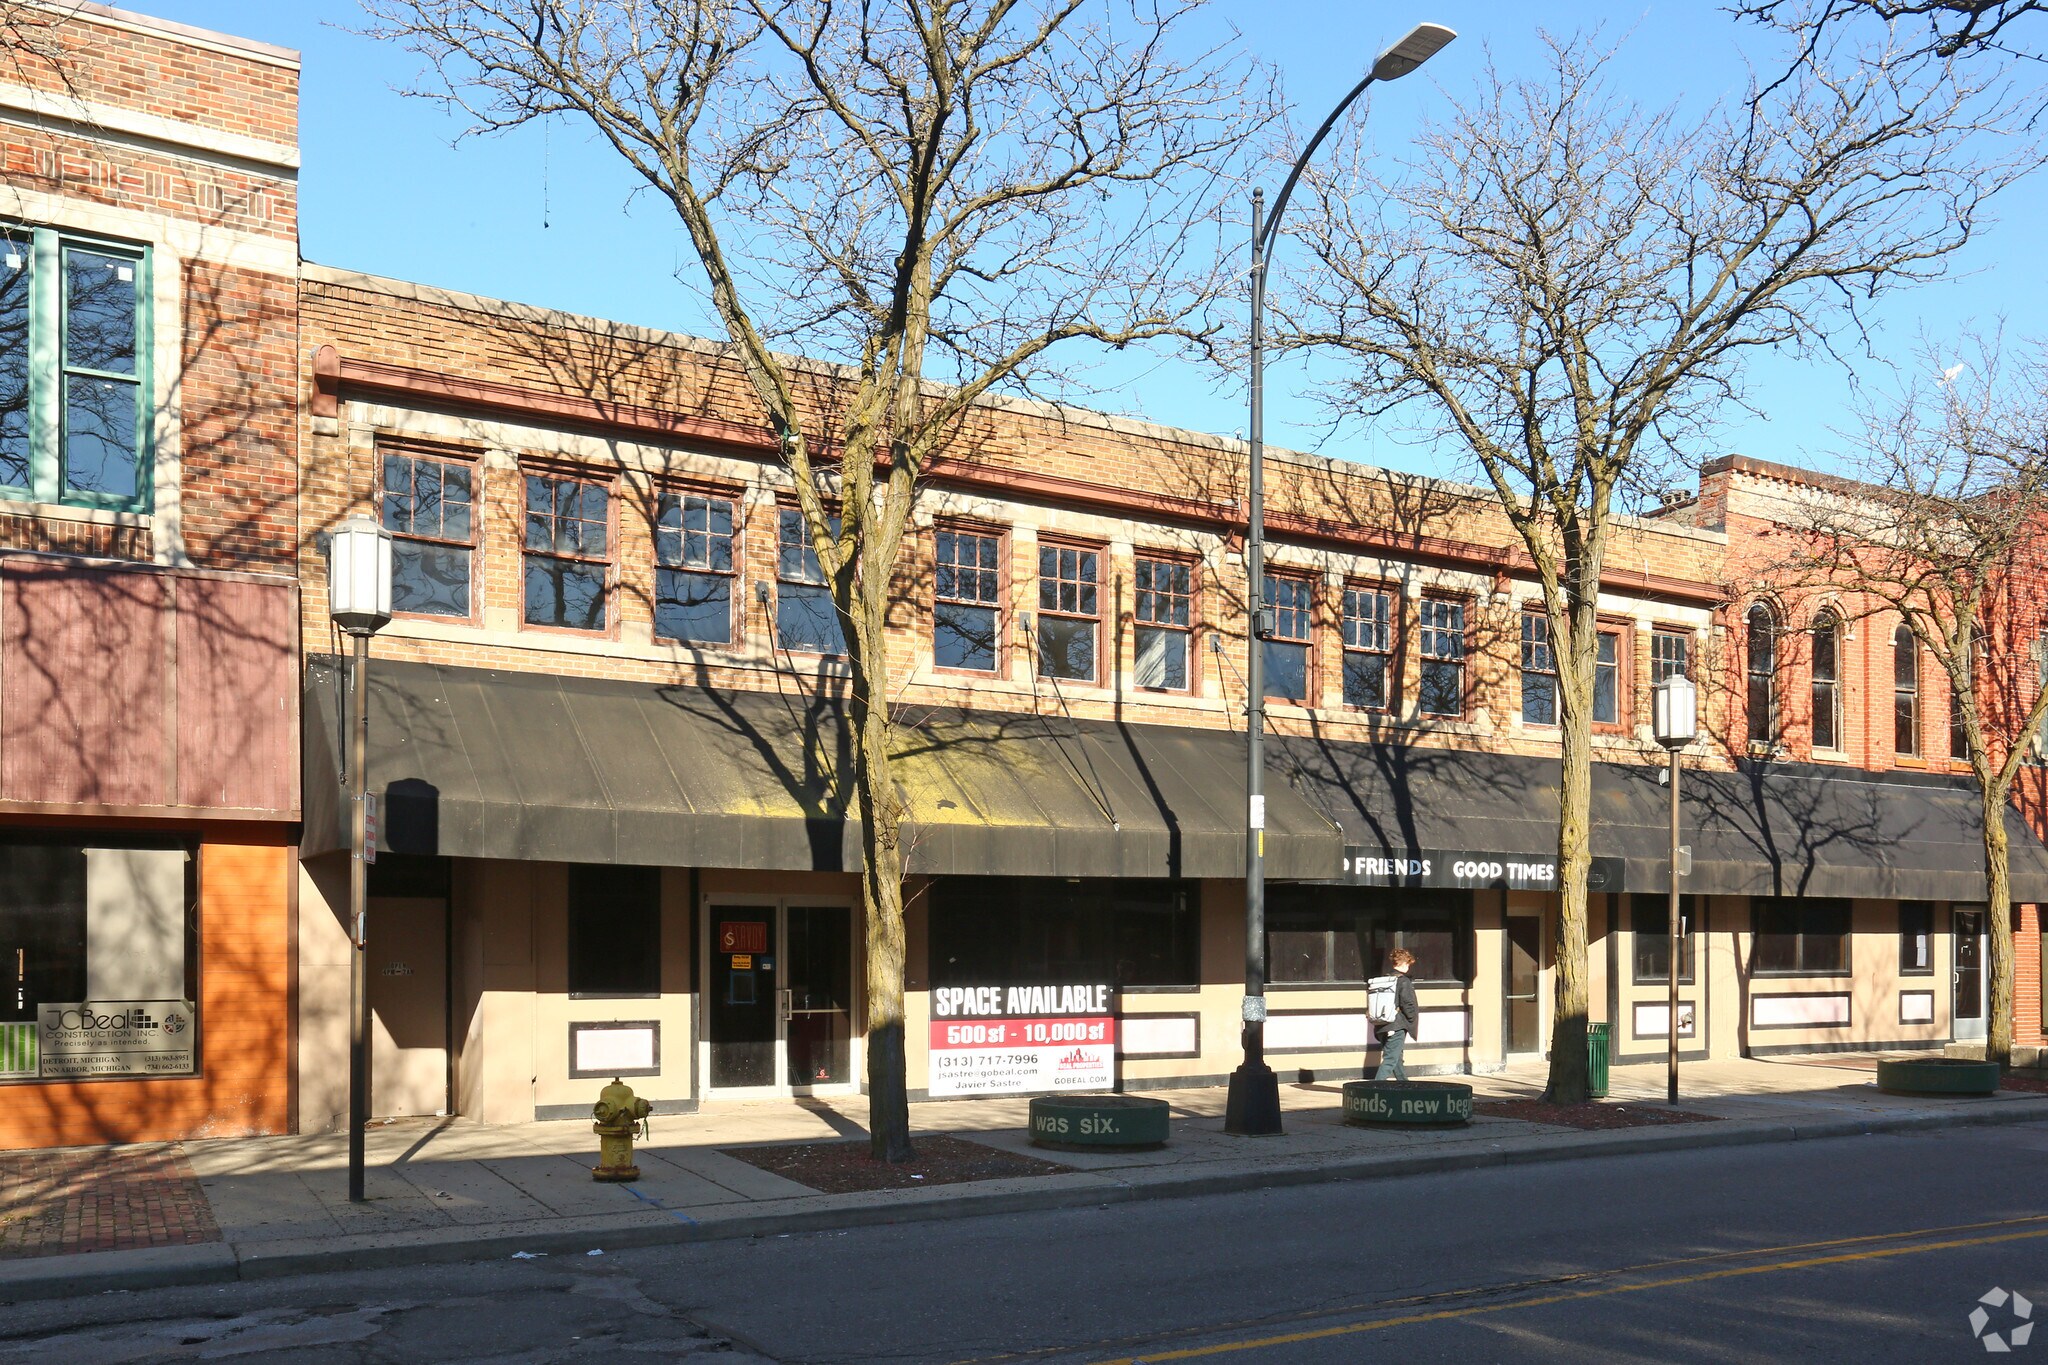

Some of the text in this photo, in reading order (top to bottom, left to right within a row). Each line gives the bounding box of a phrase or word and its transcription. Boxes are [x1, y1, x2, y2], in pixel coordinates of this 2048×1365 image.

[1355, 857, 1431, 876] FRIENDS
[1453, 861, 1502, 878] GOOD
[1506, 862, 1554, 881] TIMES
[936, 985, 1107, 1016] SPACE AVAILABLE
[45, 1029, 159, 1039] CONSTRUCTION INC.
[111, 1038, 150, 1046] intended.
[43, 1057, 79, 1065] DETROIT,
[938, 1054, 1038, 1068] (313) 717-7996
[91, 1064, 131, 1072] MICHIGAN
[955, 1079, 1021, 1089] Javier Sastre
[1054, 1076, 1107, 1085] GOBEAL.COM
[1401, 1099, 1440, 1114] new
[1036, 1113, 1120, 1134] was six.
